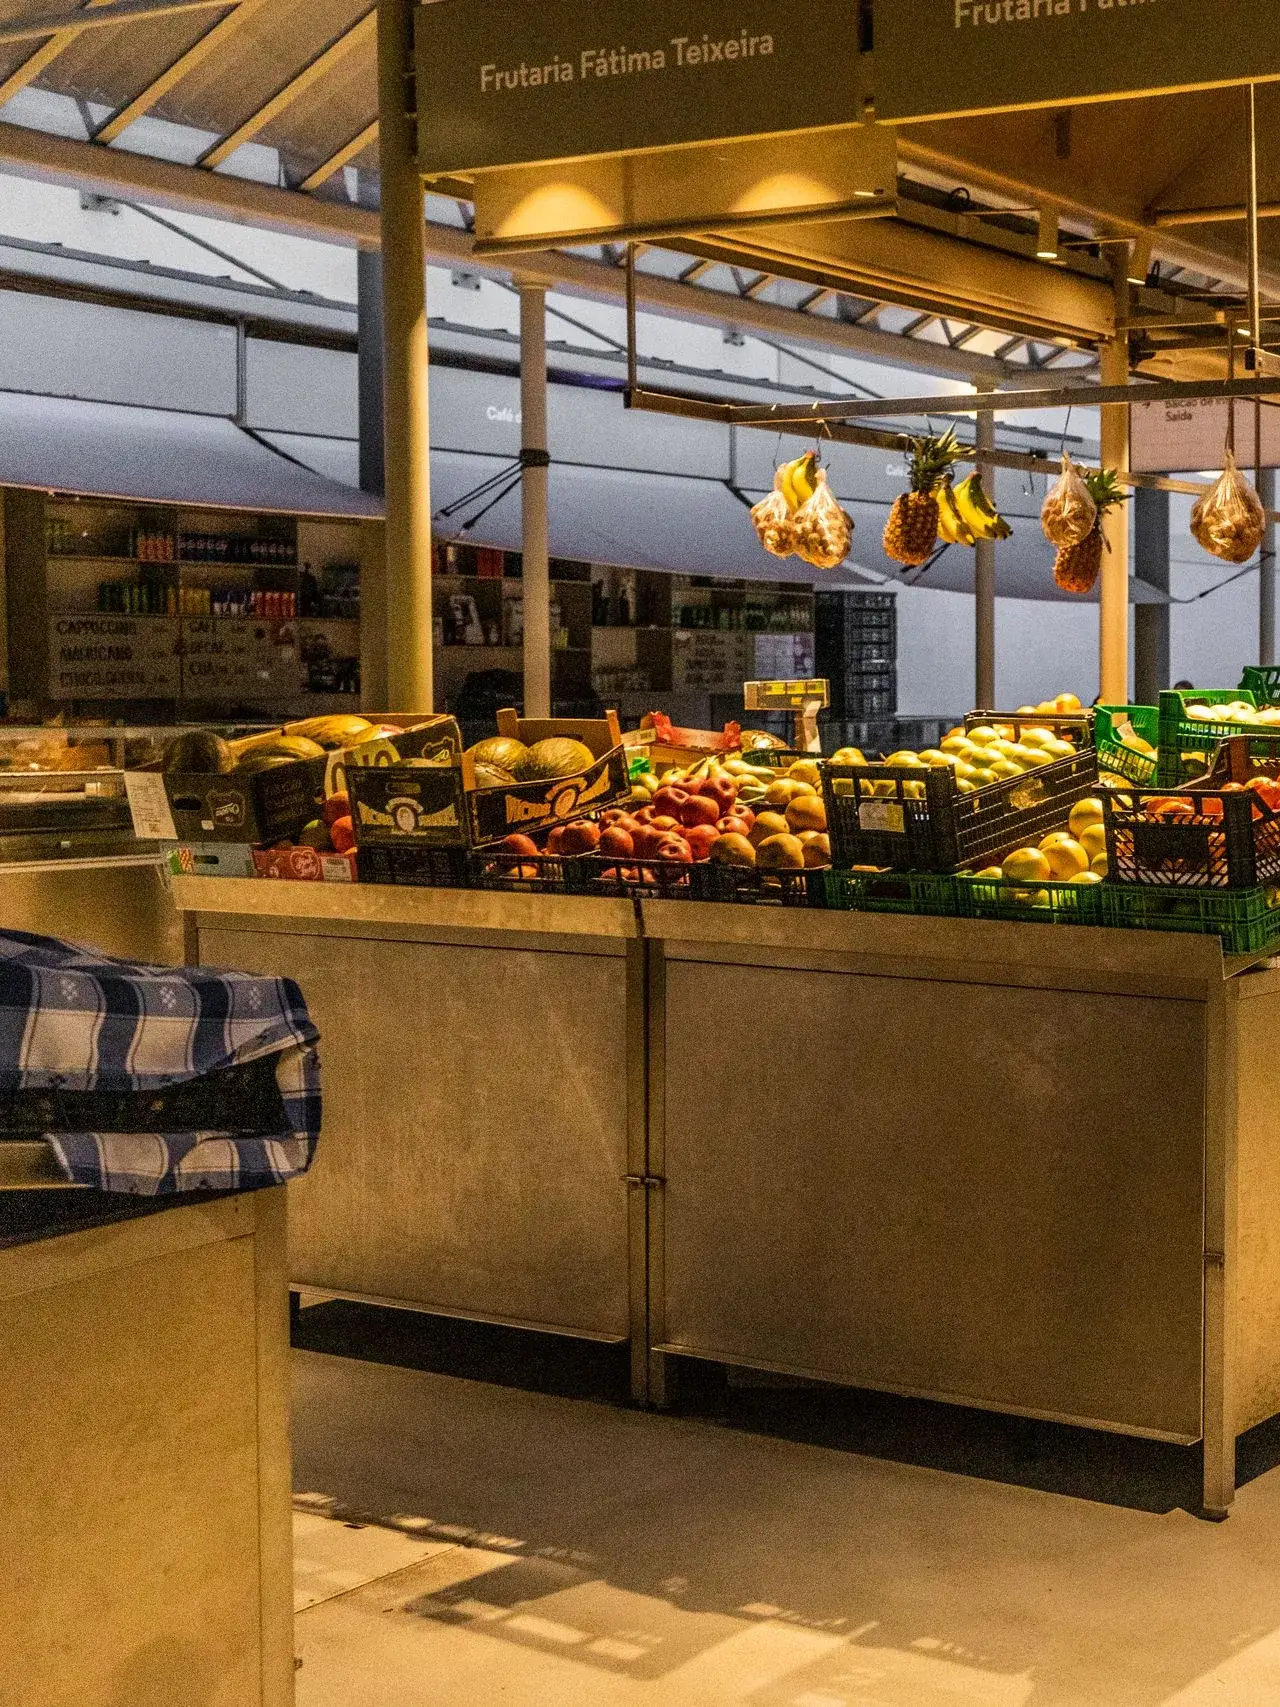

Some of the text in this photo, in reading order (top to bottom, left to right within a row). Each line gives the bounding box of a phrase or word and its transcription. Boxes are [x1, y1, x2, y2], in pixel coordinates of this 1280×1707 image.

[480, 29, 774, 92] Frutaria Fátima Teixeira
